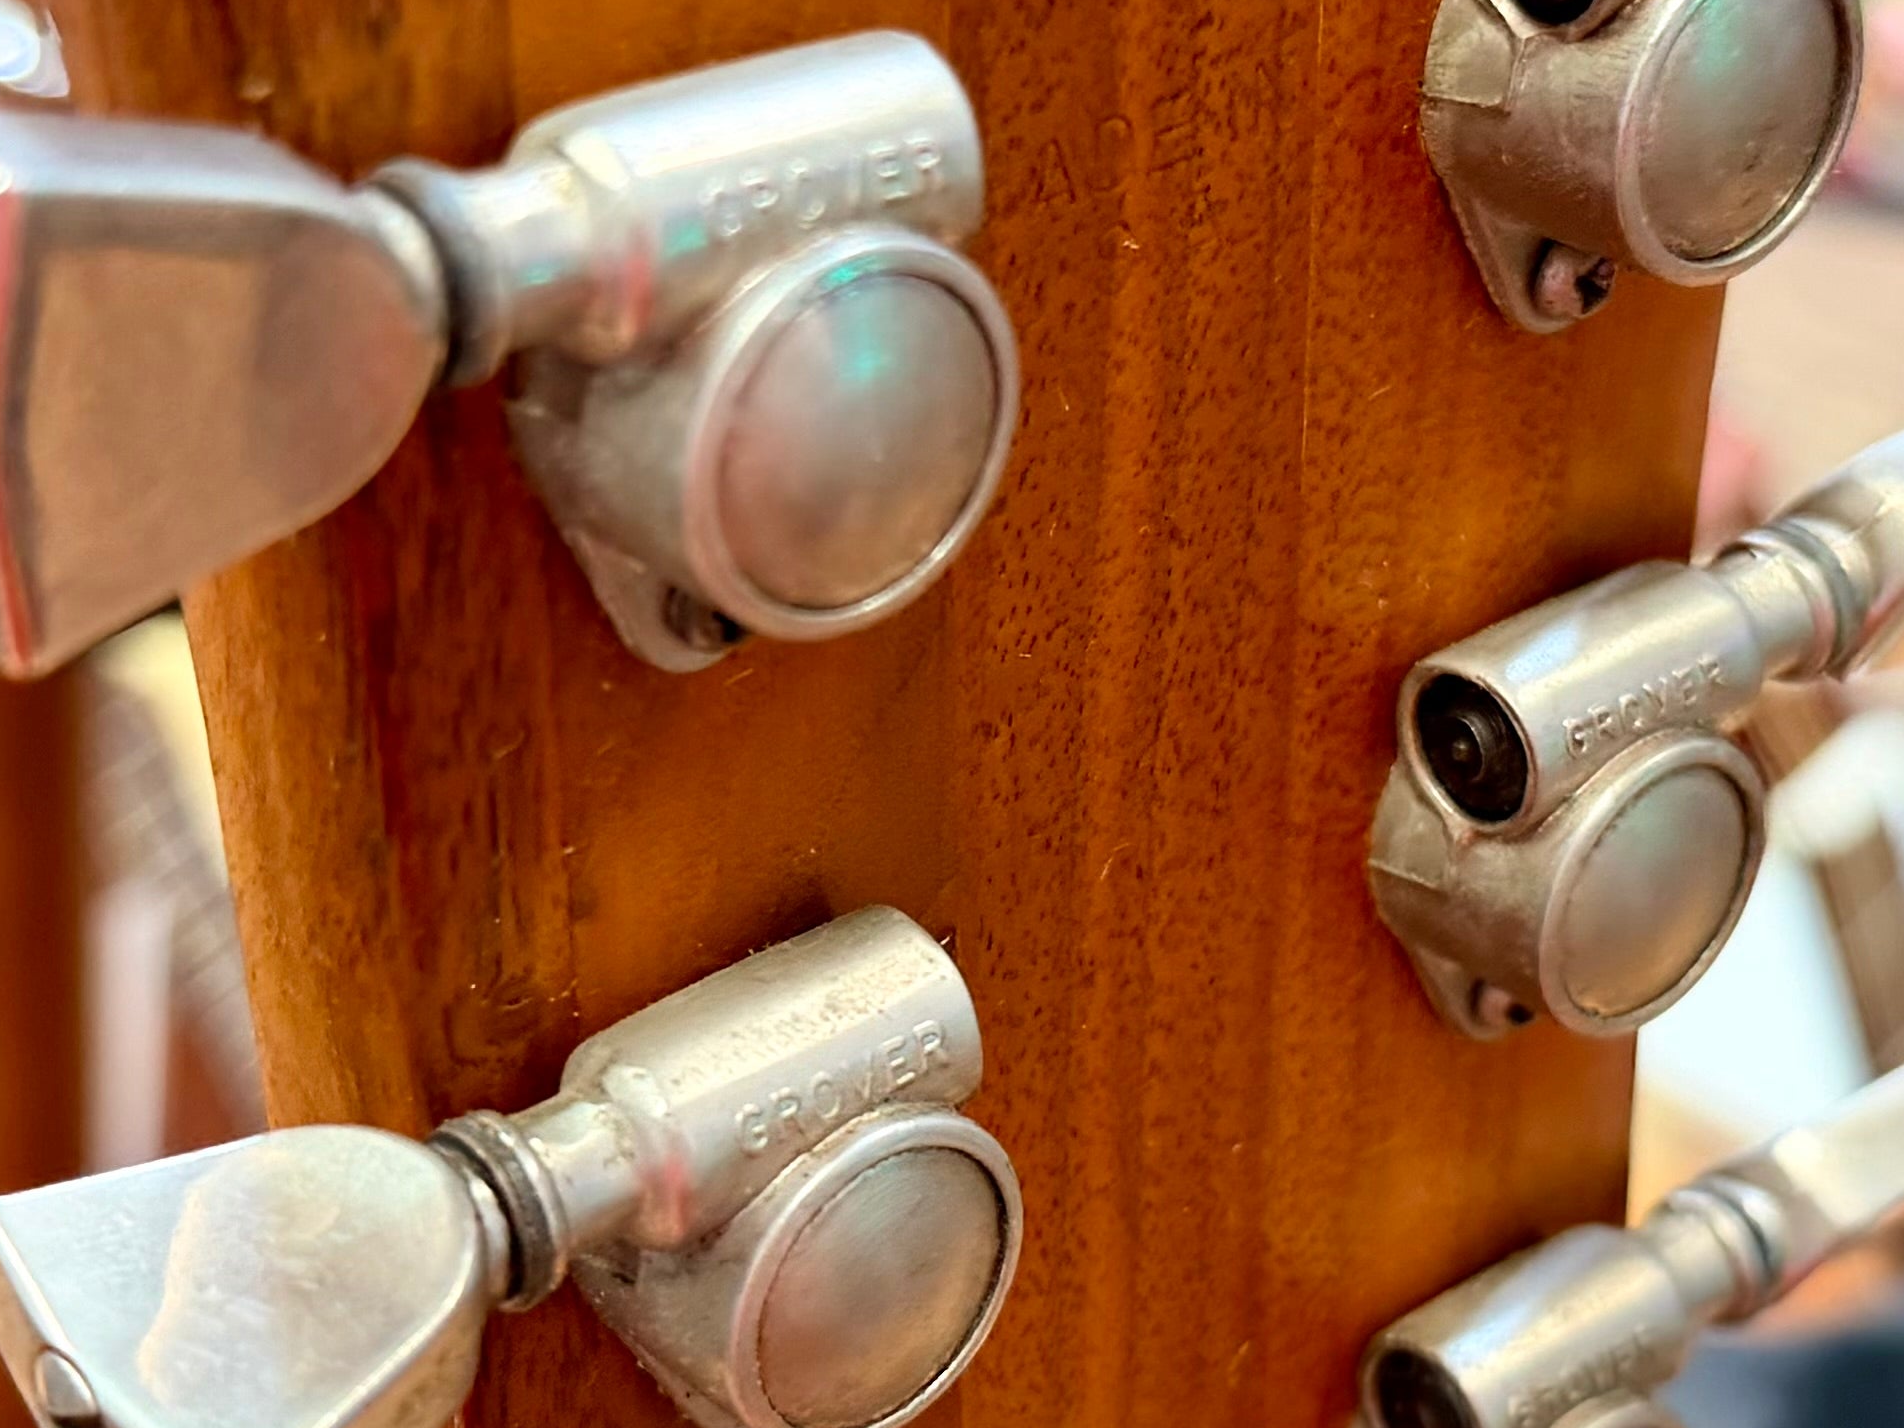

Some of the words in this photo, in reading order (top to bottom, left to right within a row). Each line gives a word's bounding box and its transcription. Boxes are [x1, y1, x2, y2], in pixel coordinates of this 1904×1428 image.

[700, 134, 944, 240] GROVER
[1562, 654, 1726, 760] GROVER
[733, 1018, 948, 1156] GROVER
